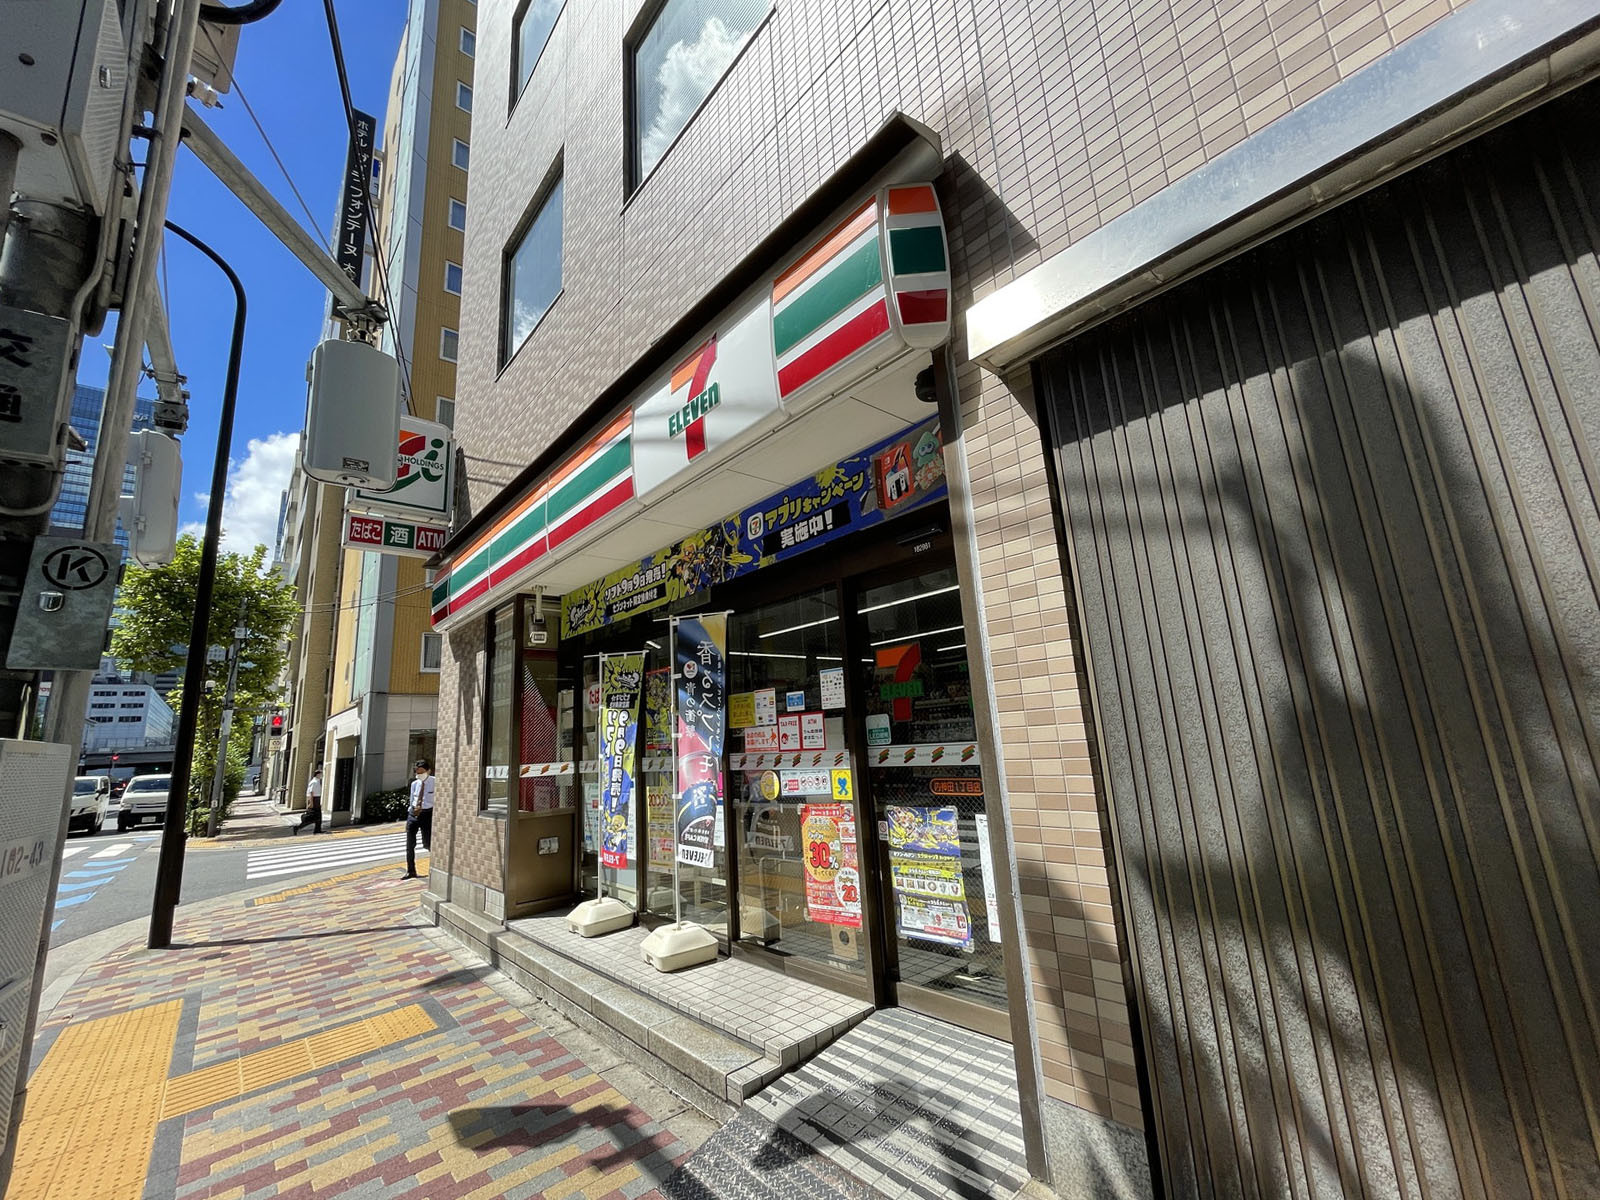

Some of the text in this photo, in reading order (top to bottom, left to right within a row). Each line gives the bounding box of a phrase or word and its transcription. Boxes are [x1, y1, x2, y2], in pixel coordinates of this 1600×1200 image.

[404, 455, 444, 471] HOLDINGS
[764, 472, 864, 530] アプリキャンペーン
[350, 520, 382, 540] たばこ
[389, 526, 410, 544] 酒
[417, 530, 444, 549] ATM
[57, 553, 97, 583] K
